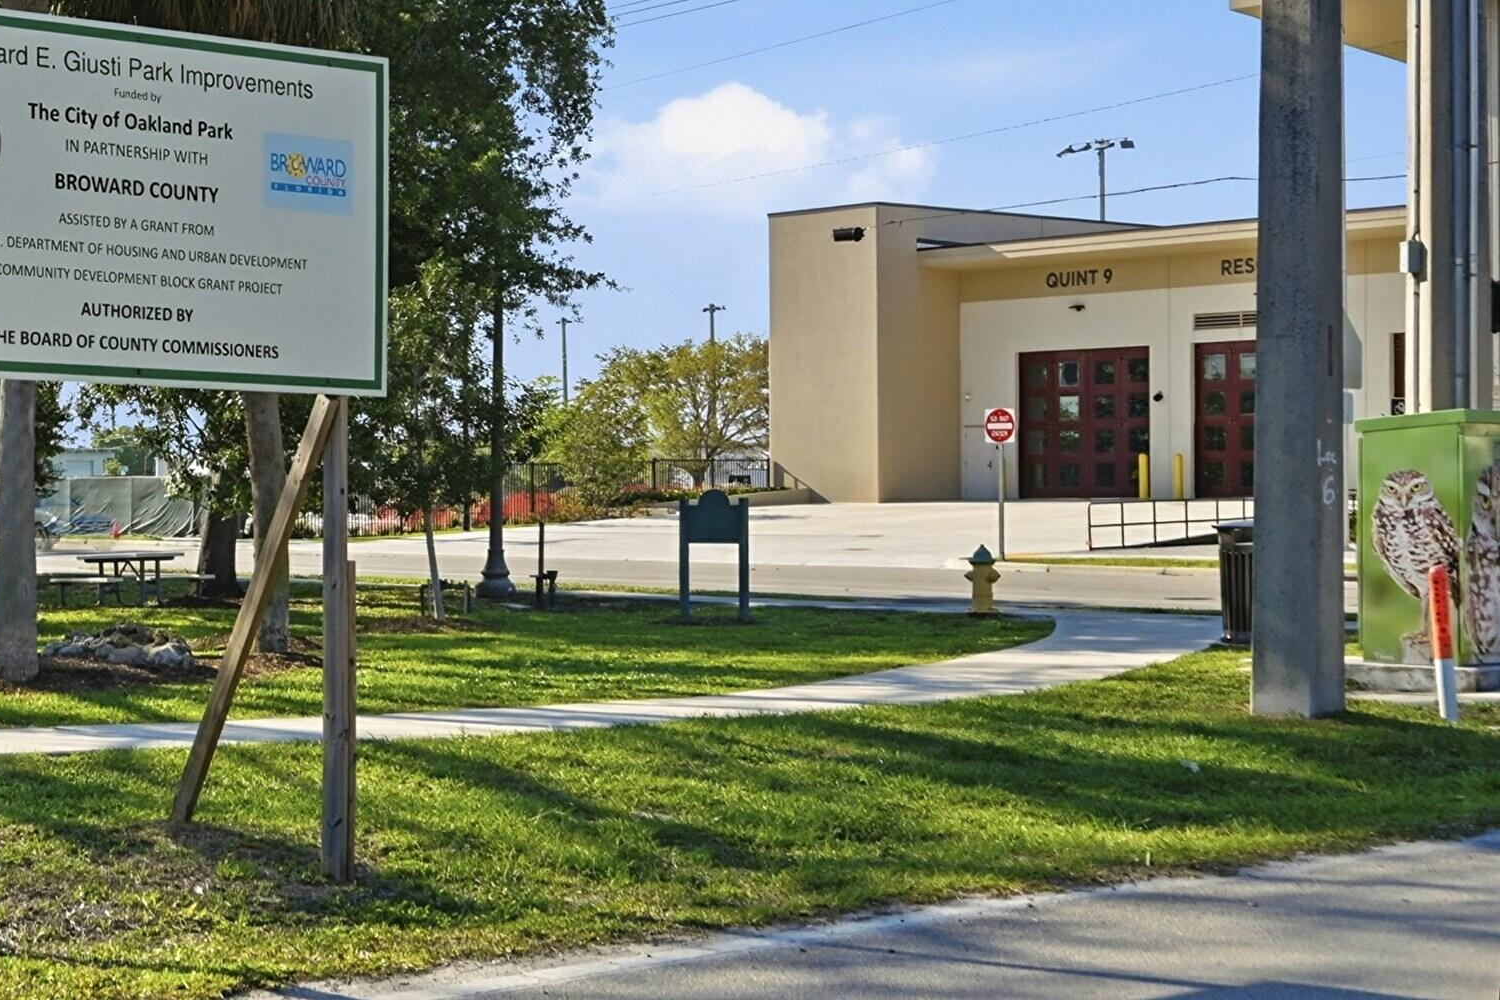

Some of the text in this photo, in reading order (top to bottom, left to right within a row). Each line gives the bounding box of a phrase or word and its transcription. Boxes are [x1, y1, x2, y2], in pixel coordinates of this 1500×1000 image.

[37, 47, 56, 69] E.
[64, 51, 121, 77] Giusti
[129, 57, 173, 84] Park
[181, 64, 314, 100] Improvements
[114, 87, 161, 104] Funded by
[28, 103, 234, 140] The City of Oakland Park
[65, 138, 209, 166] IN PARTNERSHIP WITH
[271, 152, 346, 177] BROWARD
[55, 173, 219, 203] BROWARD COUNTY
[59, 212, 215, 237] ASSISTED BY A GRANT FROM
[7, 235, 85, 253] DEPARTMENT
[88, 242, 103, 255] OF
[106, 244, 158, 260] HOUSING
[161, 248, 186, 262] AND
[188, 251, 227, 265] URBAN
[229, 253, 308, 271] DEVELOPMENT
[74, 269, 157, 286] DEVELOPMENT
[160, 275, 196, 289] BLOCK
[198, 278, 235, 292] GRANT
[238, 280, 283, 295] PROJECT
[1046, 268, 1113, 288] QUINT 9
[81, 302, 194, 322] AUTHORIZED BY
[20, 331, 73, 348] BOARD
[76, 334, 95, 349] OF
[99, 335, 158, 352] COUNTY
[162, 339, 279, 359] COMMISSIONERS
[1323, 475, 1336, 505] 6
